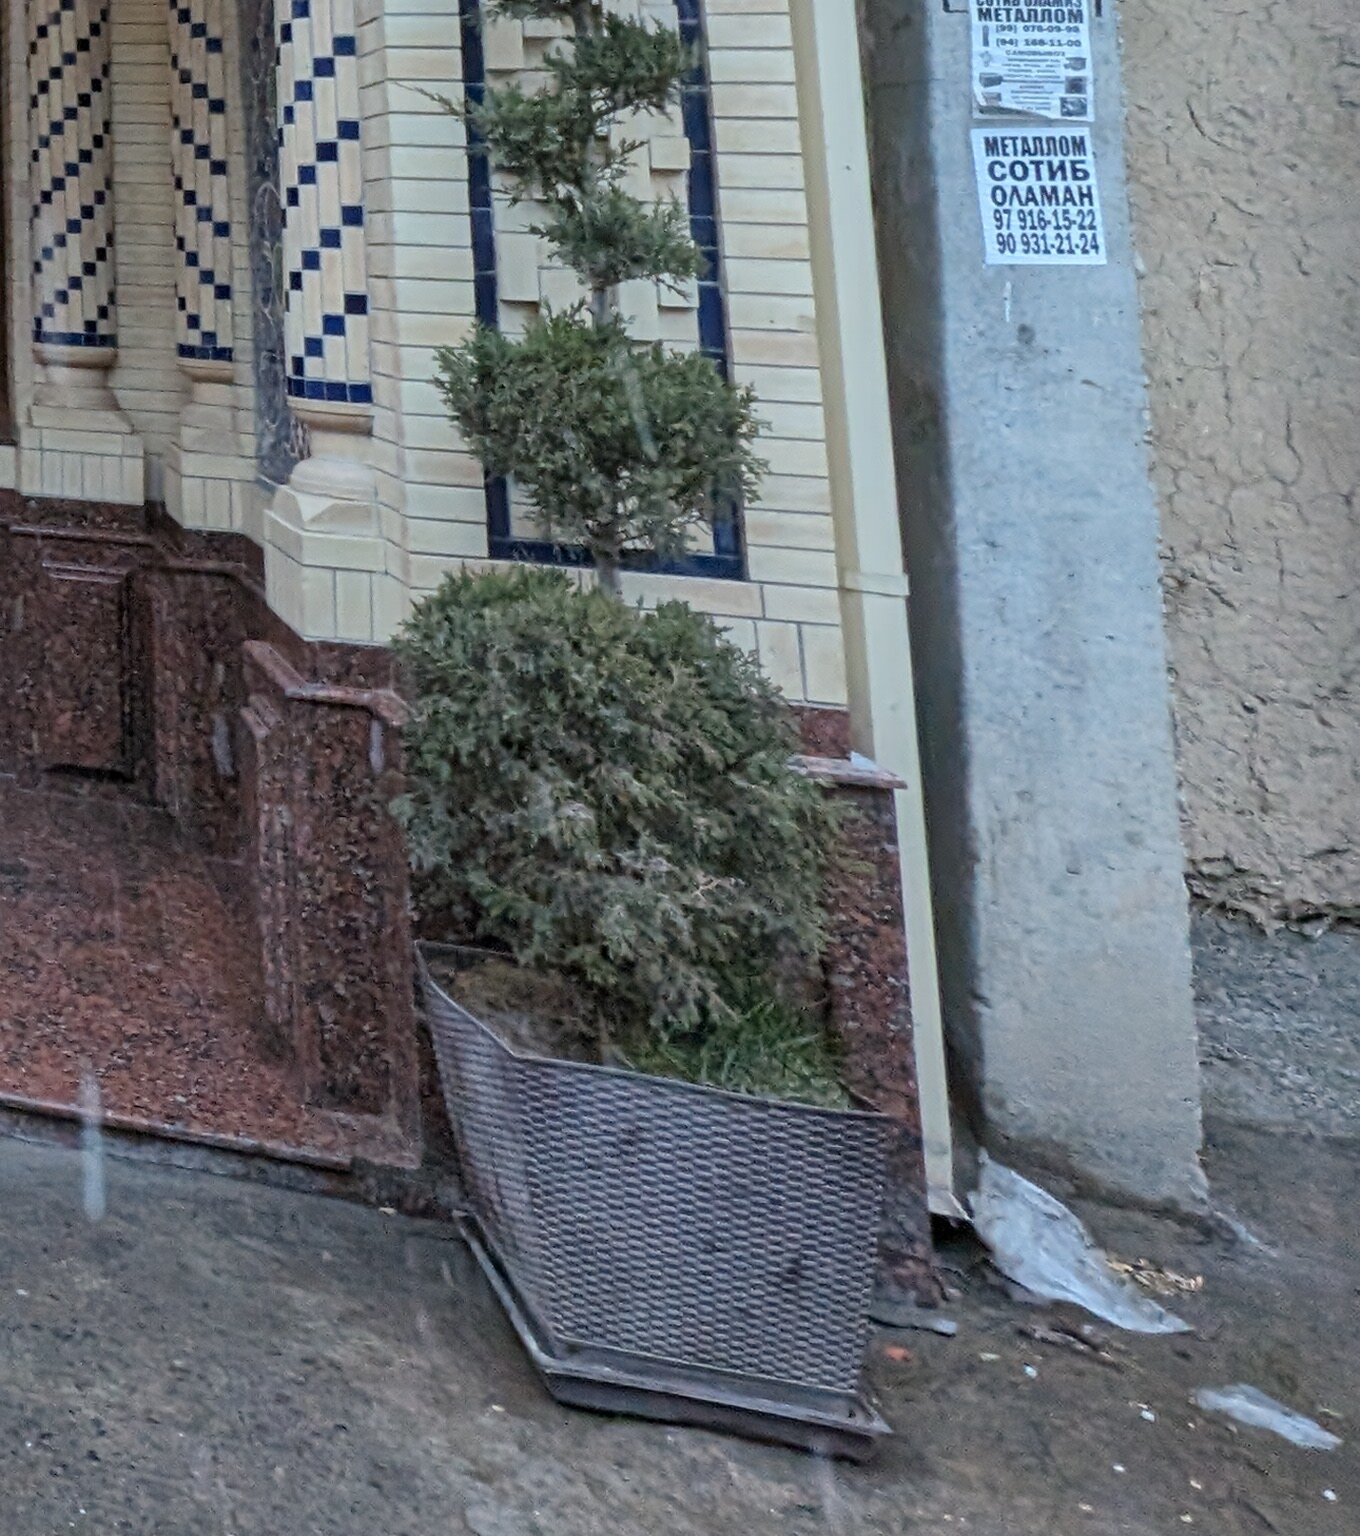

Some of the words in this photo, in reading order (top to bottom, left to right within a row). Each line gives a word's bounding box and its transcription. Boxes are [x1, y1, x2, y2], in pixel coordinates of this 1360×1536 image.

[977, 7, 1084, 24] МЕТАЛЛОМ
[983, 135, 1087, 157] МЕТАЛЛОМ
[987, 160, 1090, 182] СОТИБ
[990, 185, 1094, 207] ОЛАМАН
[993, 209, 1012, 230] 97
[1017, 209, 1097, 230] 916-15-22
[996, 232, 1016, 254] 90
[1021, 232, 1100, 254] 931-21-24
